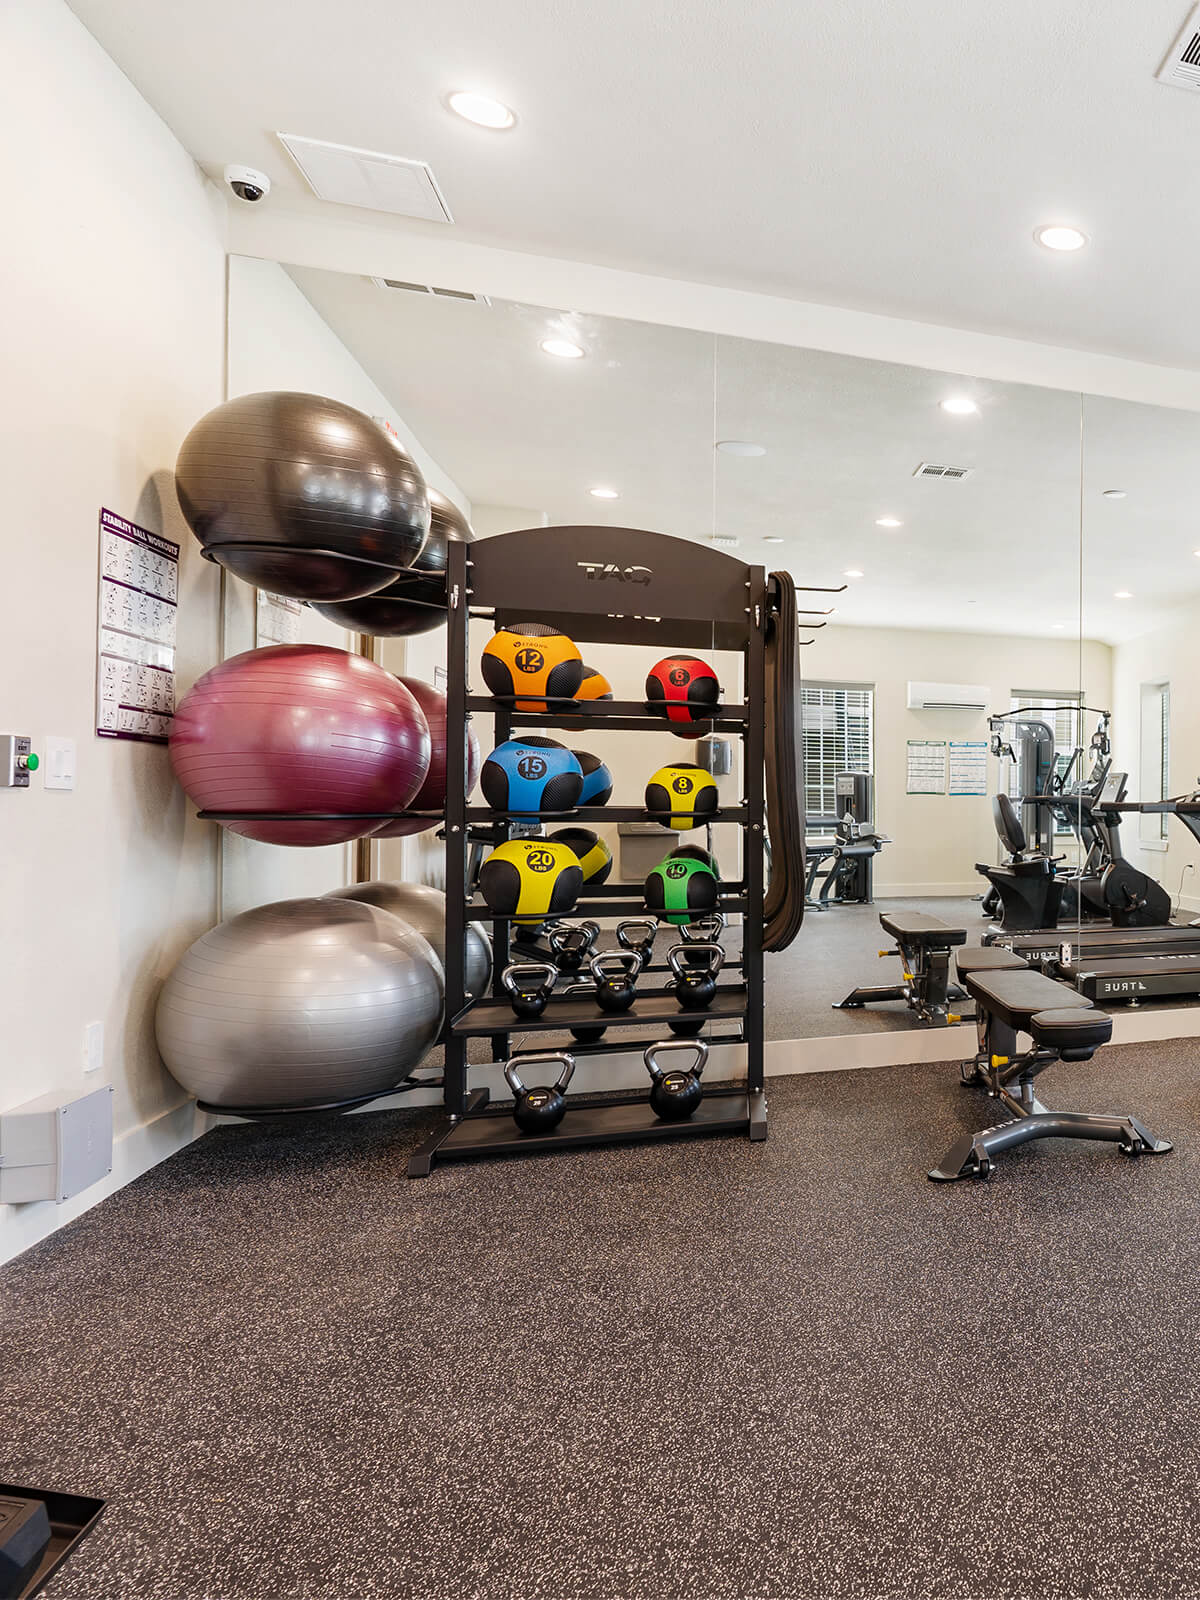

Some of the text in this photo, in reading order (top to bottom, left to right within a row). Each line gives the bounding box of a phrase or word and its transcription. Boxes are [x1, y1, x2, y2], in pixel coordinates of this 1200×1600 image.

[103, 512, 178, 556] STABILITY BALL WORKOUTS
[577, 562, 653, 586] TAG
[519, 651, 541, 666] 12
[675, 670, 685, 681] 6
[521, 759, 542, 772] 15
[679, 778, 687, 789] 8
[530, 852, 552, 866] 20
[670, 865, 685, 874] 10
